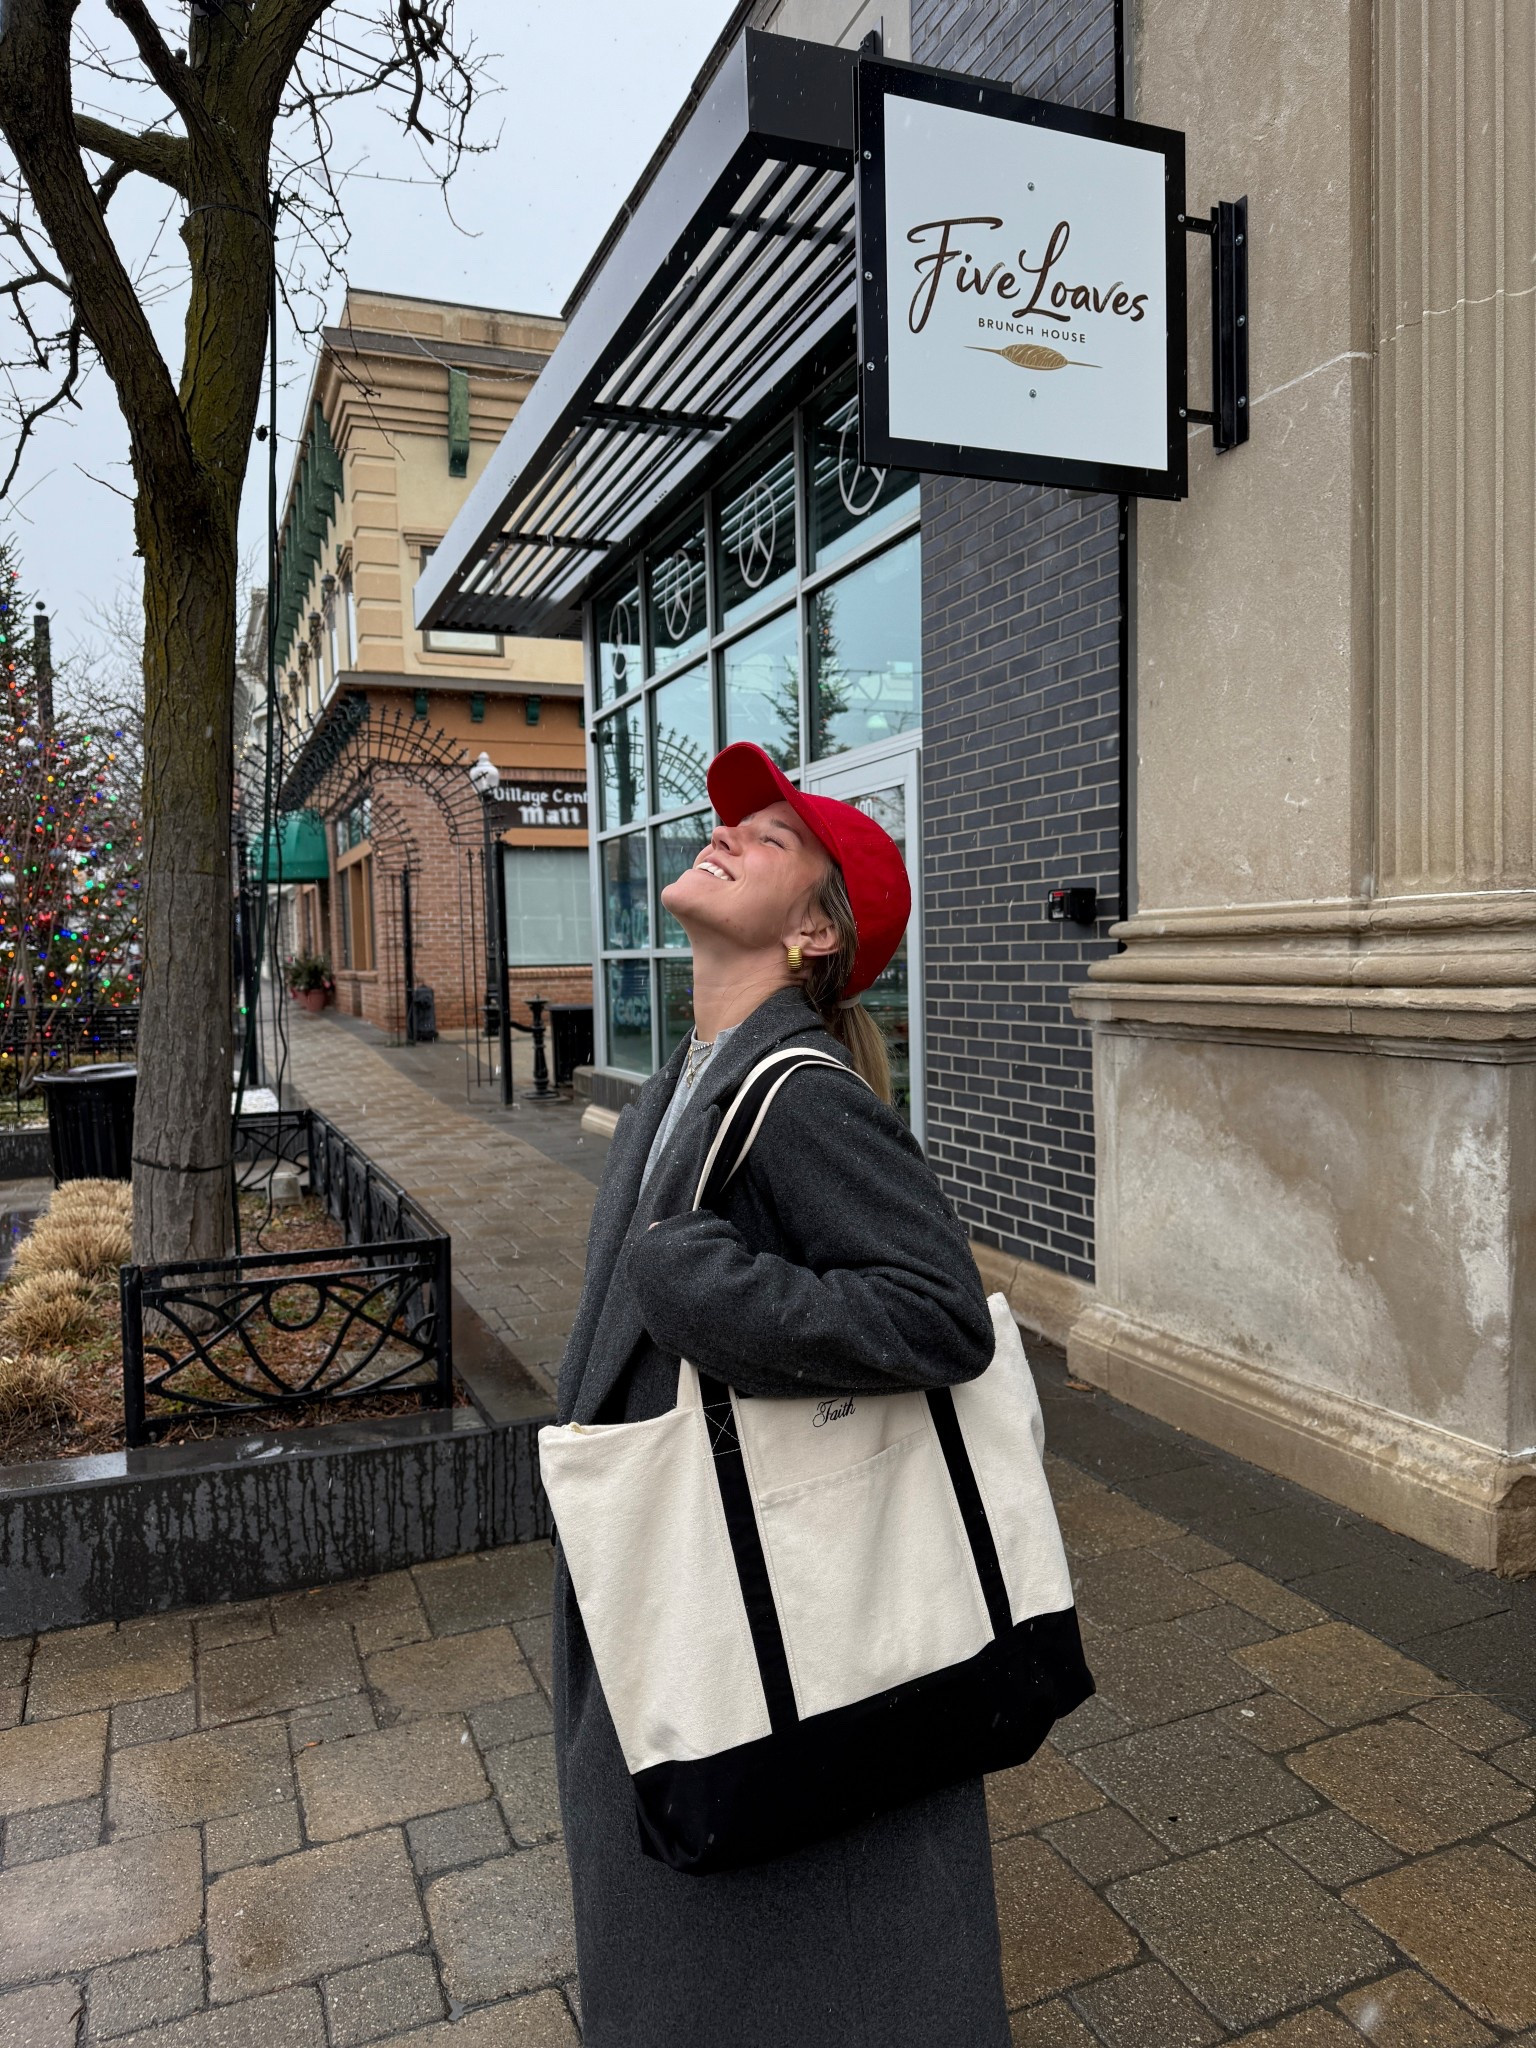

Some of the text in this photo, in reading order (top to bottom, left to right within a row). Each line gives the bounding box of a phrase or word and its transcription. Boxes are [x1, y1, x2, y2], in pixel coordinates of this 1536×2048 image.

[906, 216, 1149, 334] Five Loaves
[978, 317, 1086, 344] BRUNCH HOUSE
[493, 786, 549, 807] Village
[518, 806, 581, 826] Mall
[812, 1396, 857, 1428] Faith
